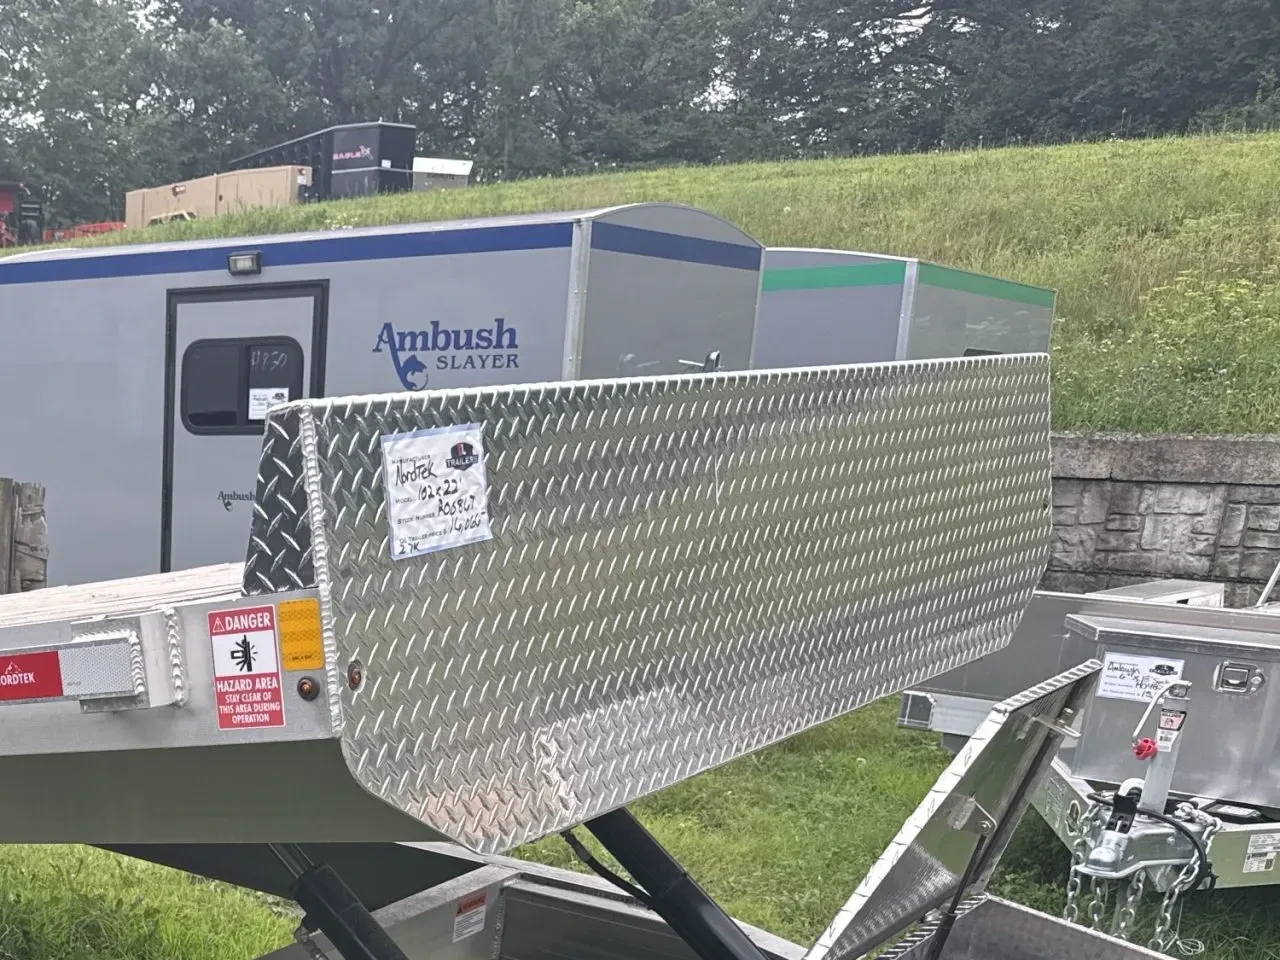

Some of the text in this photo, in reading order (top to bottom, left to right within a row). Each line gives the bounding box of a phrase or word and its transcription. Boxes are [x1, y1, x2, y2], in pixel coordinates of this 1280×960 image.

[372, 318, 519, 364] Ambush
[436, 354, 519, 370] SLAYER
[446, 454, 479, 468] TRAILERS
[225, 612, 271, 631] DANGER
[217, 677, 279, 693] HAZARD AREA
[225, 692, 272, 703] STAY CLEAR OF
[219, 702, 280, 714] THIS AREA DURING
[232, 713, 270, 723] OPERATION
